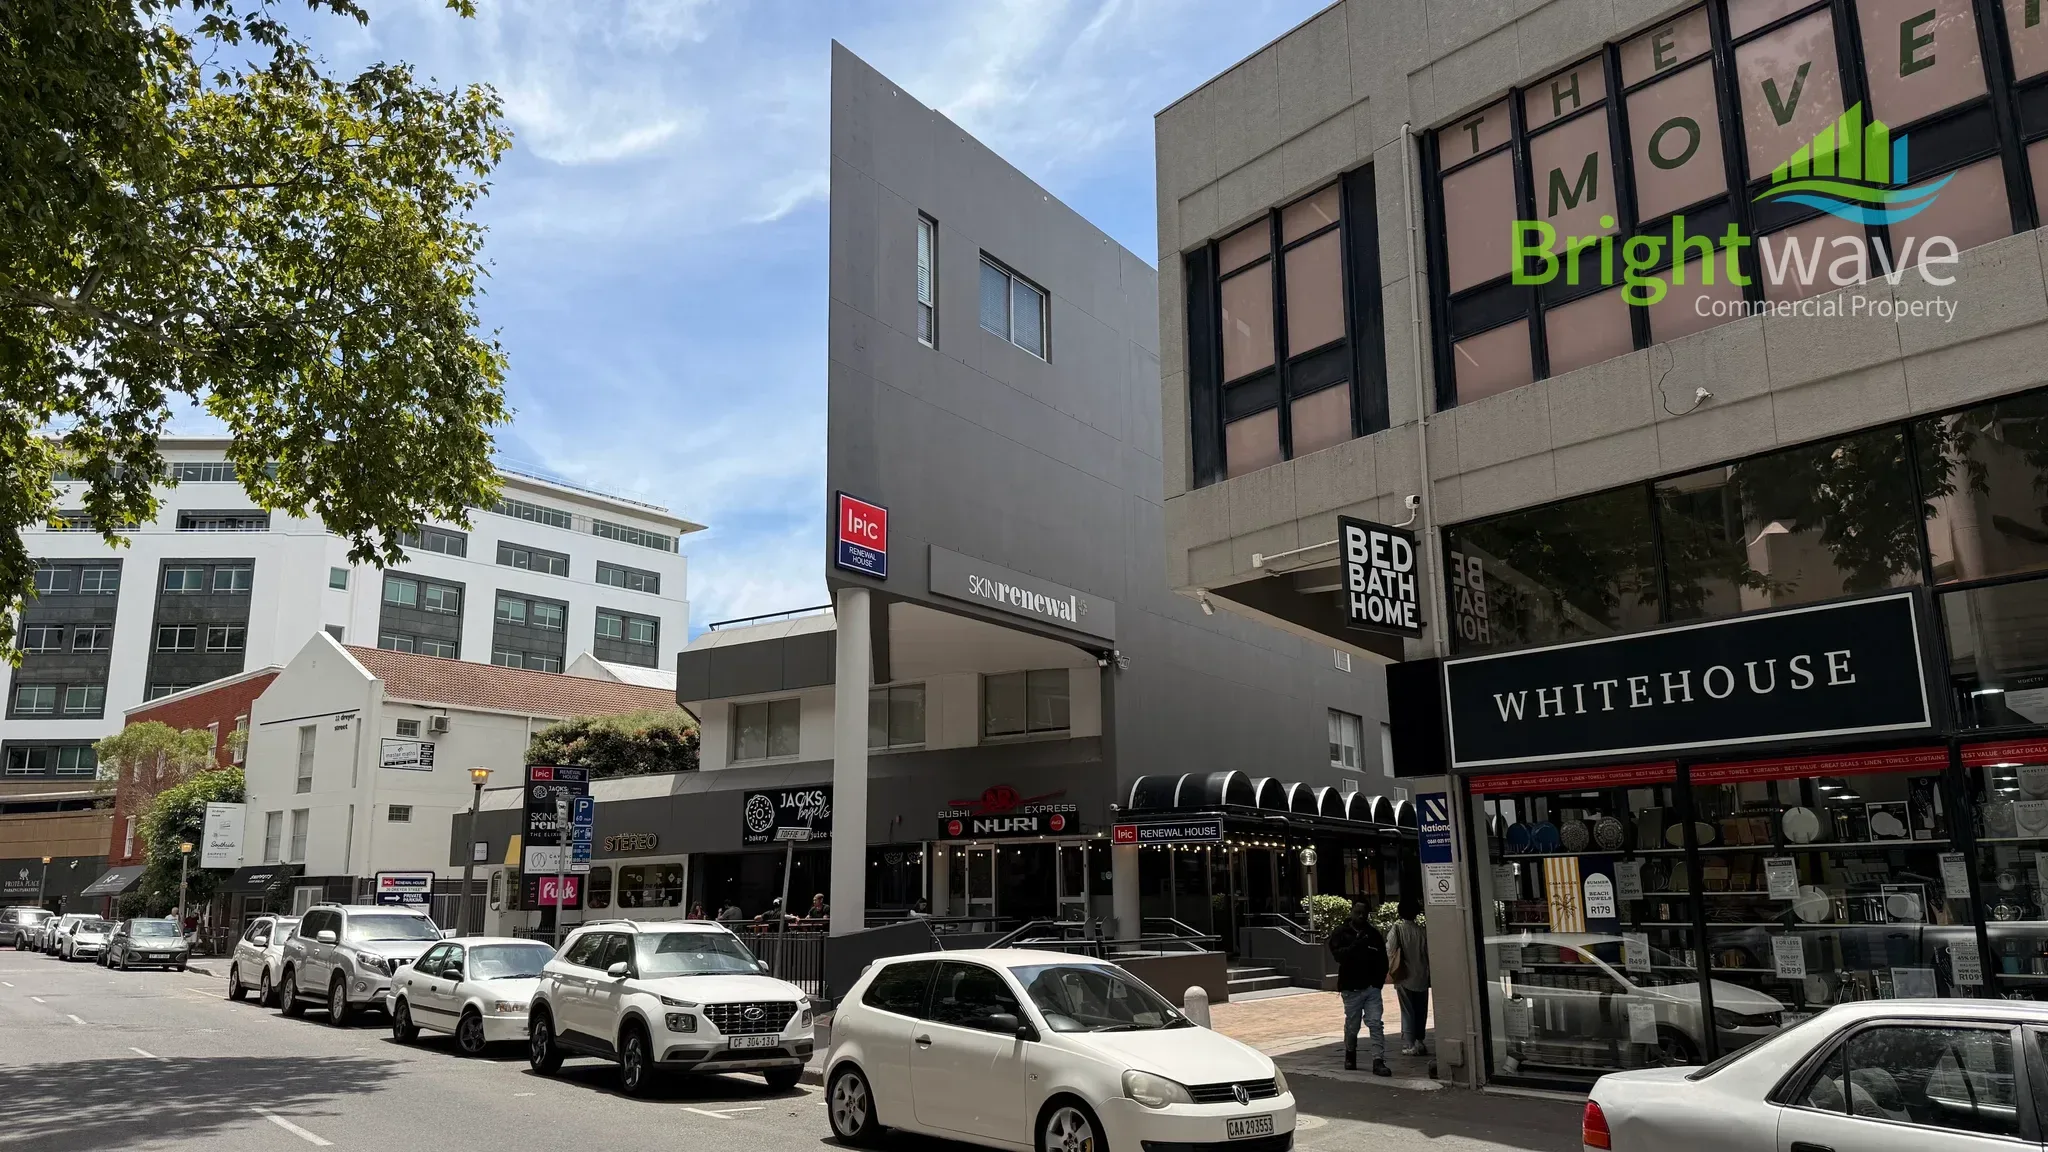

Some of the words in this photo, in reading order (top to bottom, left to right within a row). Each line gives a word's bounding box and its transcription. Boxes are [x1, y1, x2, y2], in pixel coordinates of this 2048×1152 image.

[849, 546, 877, 562] RENEWAL
[1346, 525, 1413, 573] BED
[852, 555, 874, 568] HOUSE
[1348, 562, 1416, 603] BATH
[1350, 592, 1419, 629] HOME
[1493, 649, 1857, 723] WHITEHOUSE
[1914, 754, 1946, 762] CURTAINS
[780, 790, 823, 808] JACKS
[579, 801, 589, 813] P
[937, 810, 971, 819] SUSHI
[1024, 803, 1078, 814] EXPRESS
[531, 812, 552, 821] SKIN
[748, 834, 769, 843] bakery
[1140, 827, 1182, 839] RENEWAL
[1184, 826, 1217, 837] HOUSE
[603, 833, 658, 852] STEREO
[1591, 906, 1611, 914] R179
[1781, 967, 1802, 975] R599
[734, 1037, 742, 1048] CF
[1229, 1121, 1245, 1136] CAA
[1246, 1117, 1274, 1135] 293553
